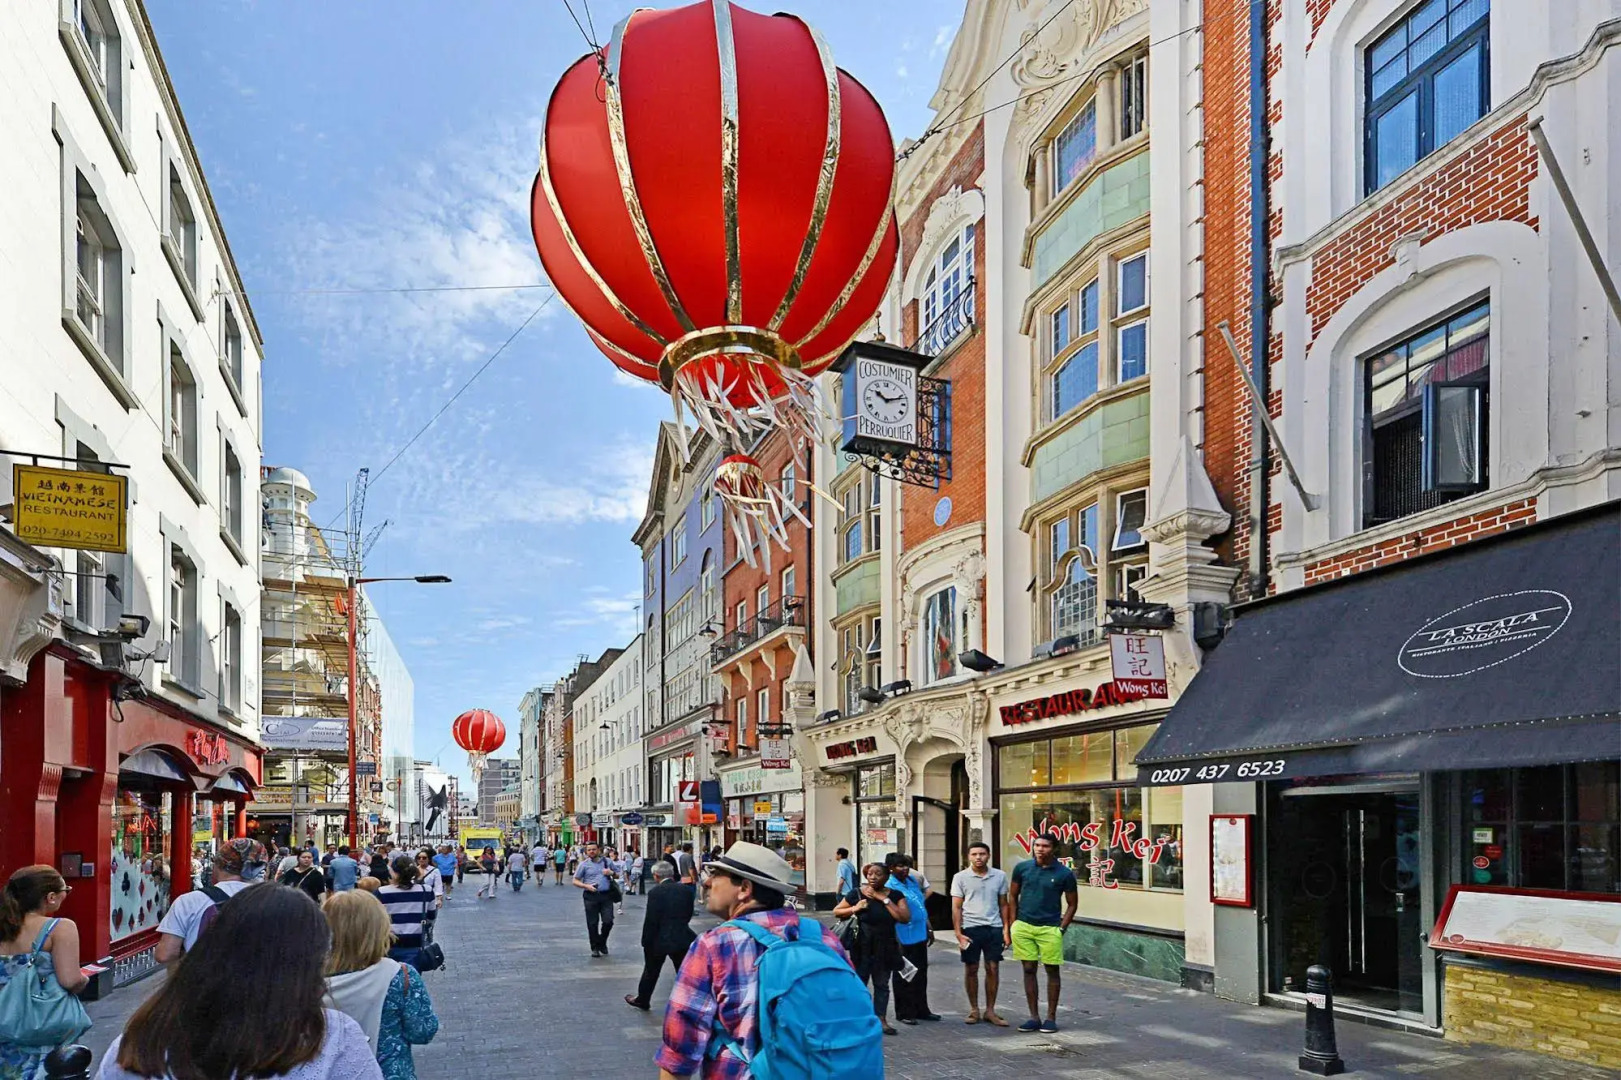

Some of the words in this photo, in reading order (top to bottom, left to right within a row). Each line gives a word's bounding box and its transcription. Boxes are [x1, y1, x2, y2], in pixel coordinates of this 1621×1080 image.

[859, 361, 913, 389] COSTUMIER
[859, 415, 913, 441] PERRUQUIER
[23, 492, 115, 510] VIETNAMESE
[23, 505, 115, 520] RESTAURANT
[1428, 628, 1456, 641] LA
[1462, 611, 1539, 635] SCALA
[1444, 627, 1511, 645] LONDON
[1126, 637, 1152, 677] 旺記
[1411, 646, 1455, 658] RISTORANTE
[1457, 640, 1494, 650] ITALIANO
[1500, 632, 1537, 643] PIZZERIA
[1117, 680, 1149, 697] Wong
[1151, 682, 1167, 694] Kei
[825, 740, 857, 760] WONG
[855, 736, 877, 754] KEI
[762, 760, 780, 768] Wong
[780, 760, 790, 768] Kei
[1151, 768, 1191, 783] 0207
[1196, 764, 1230, 780] 437
[1237, 760, 1285, 777] 6523
[1014, 817, 1102, 854] Wong
[1111, 818, 1167, 864] Kei
